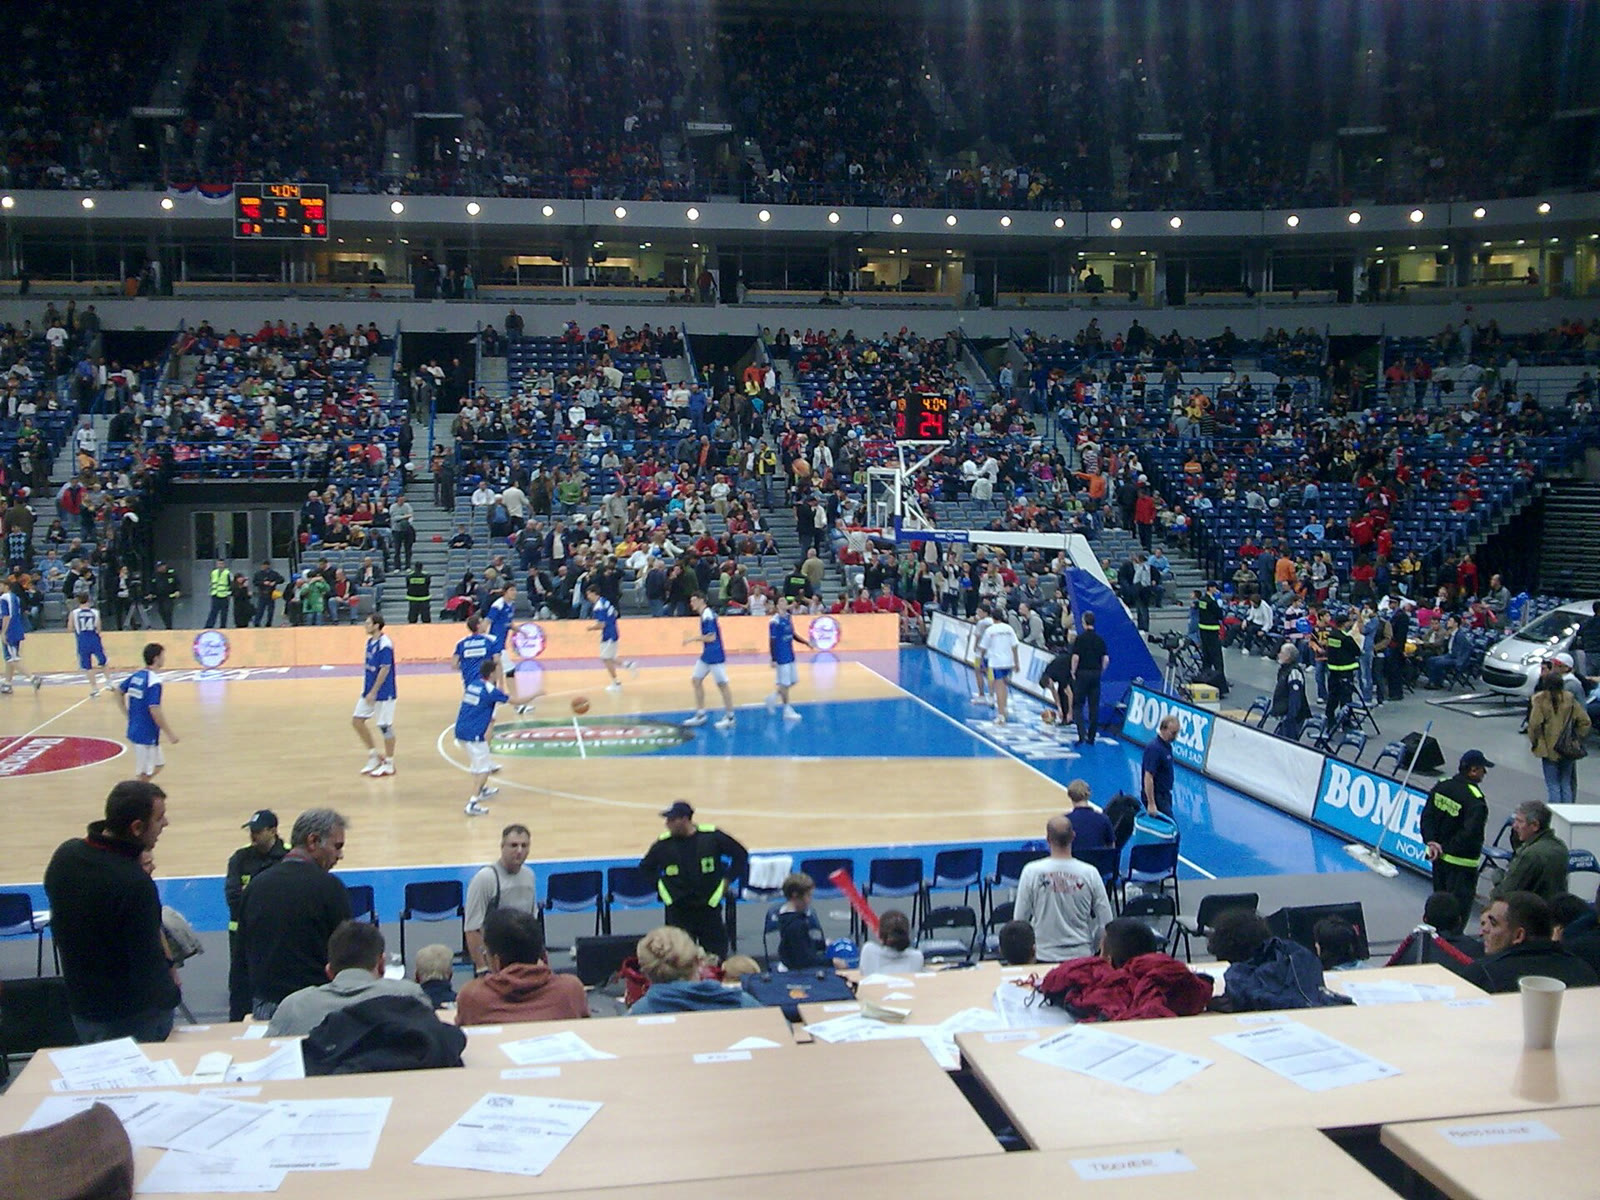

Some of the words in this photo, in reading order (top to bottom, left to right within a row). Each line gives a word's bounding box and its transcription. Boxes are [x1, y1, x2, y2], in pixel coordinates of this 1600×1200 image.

[920, 411, 943, 437] 24
[79, 616, 95, 631] 14
[1323, 763, 1428, 845] BOME
[1396, 839, 1427, 862] NOVI
